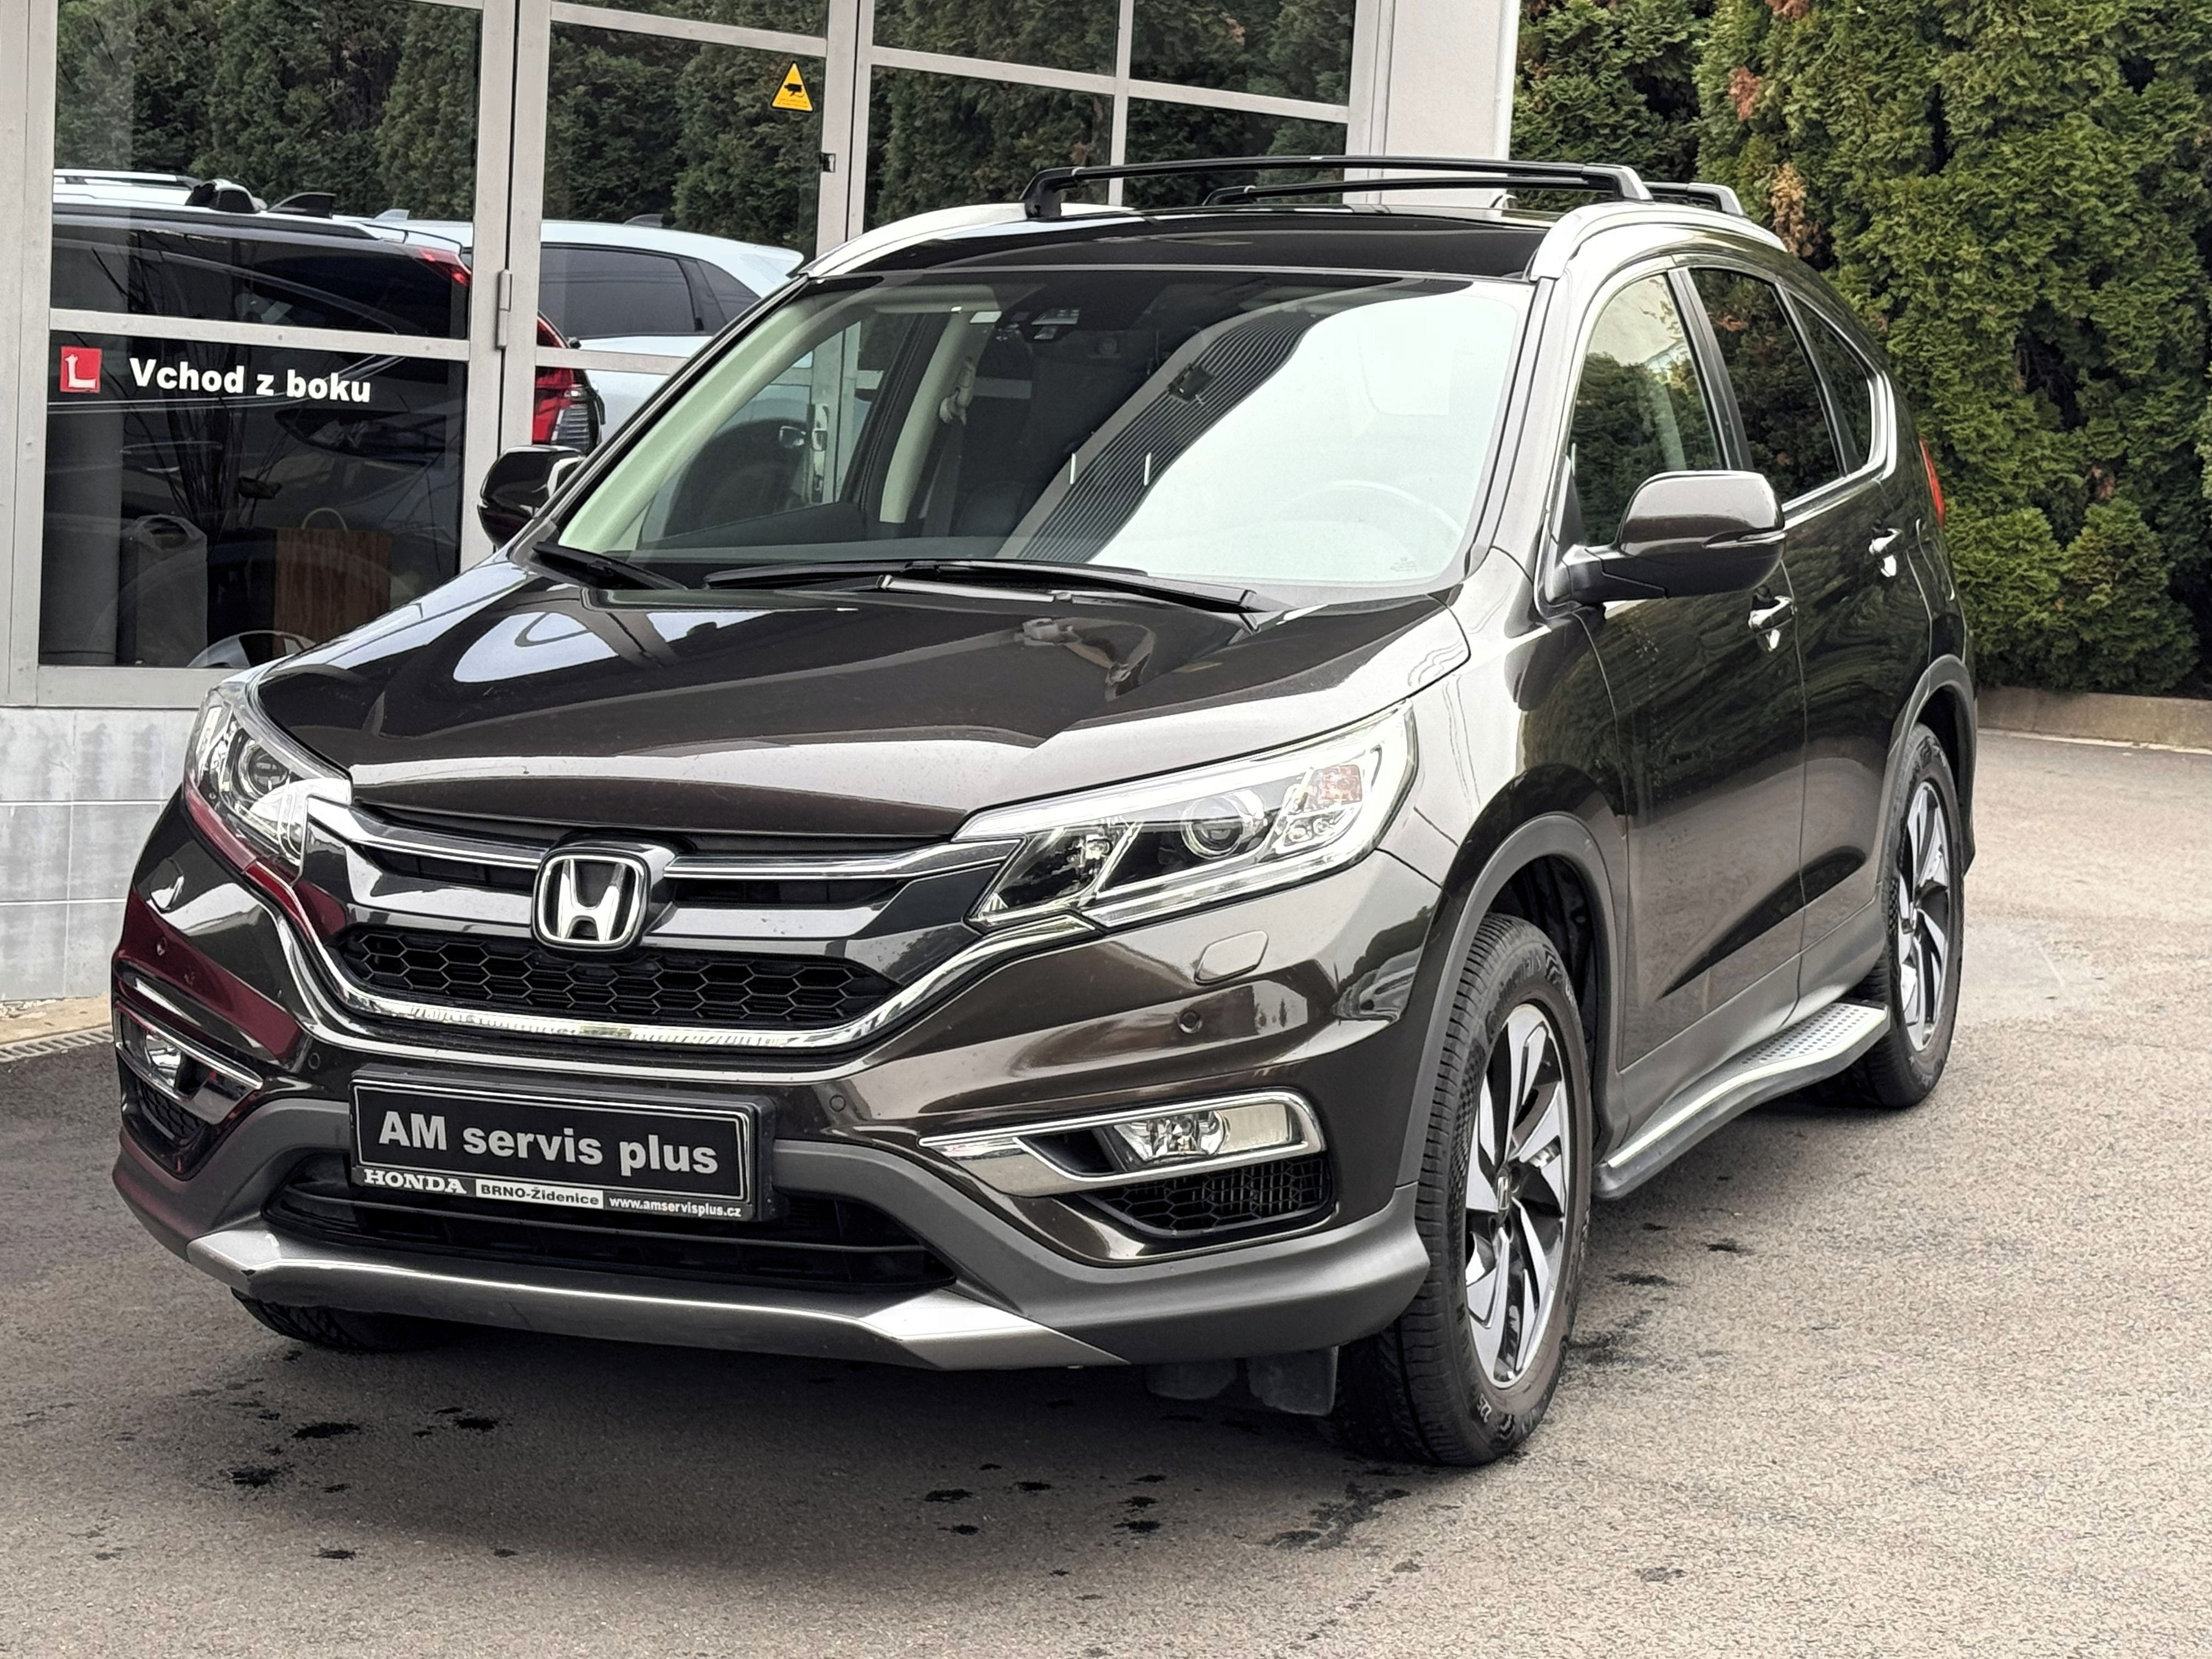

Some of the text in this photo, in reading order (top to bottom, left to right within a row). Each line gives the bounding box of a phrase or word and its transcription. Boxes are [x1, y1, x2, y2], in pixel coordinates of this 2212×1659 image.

[129, 358, 371, 403] Vchod z boku
[379, 1110, 718, 1177] AM servis plus
[364, 1169, 741, 1217] HONDA BRNO-Židenice www.amservisplus.cz
